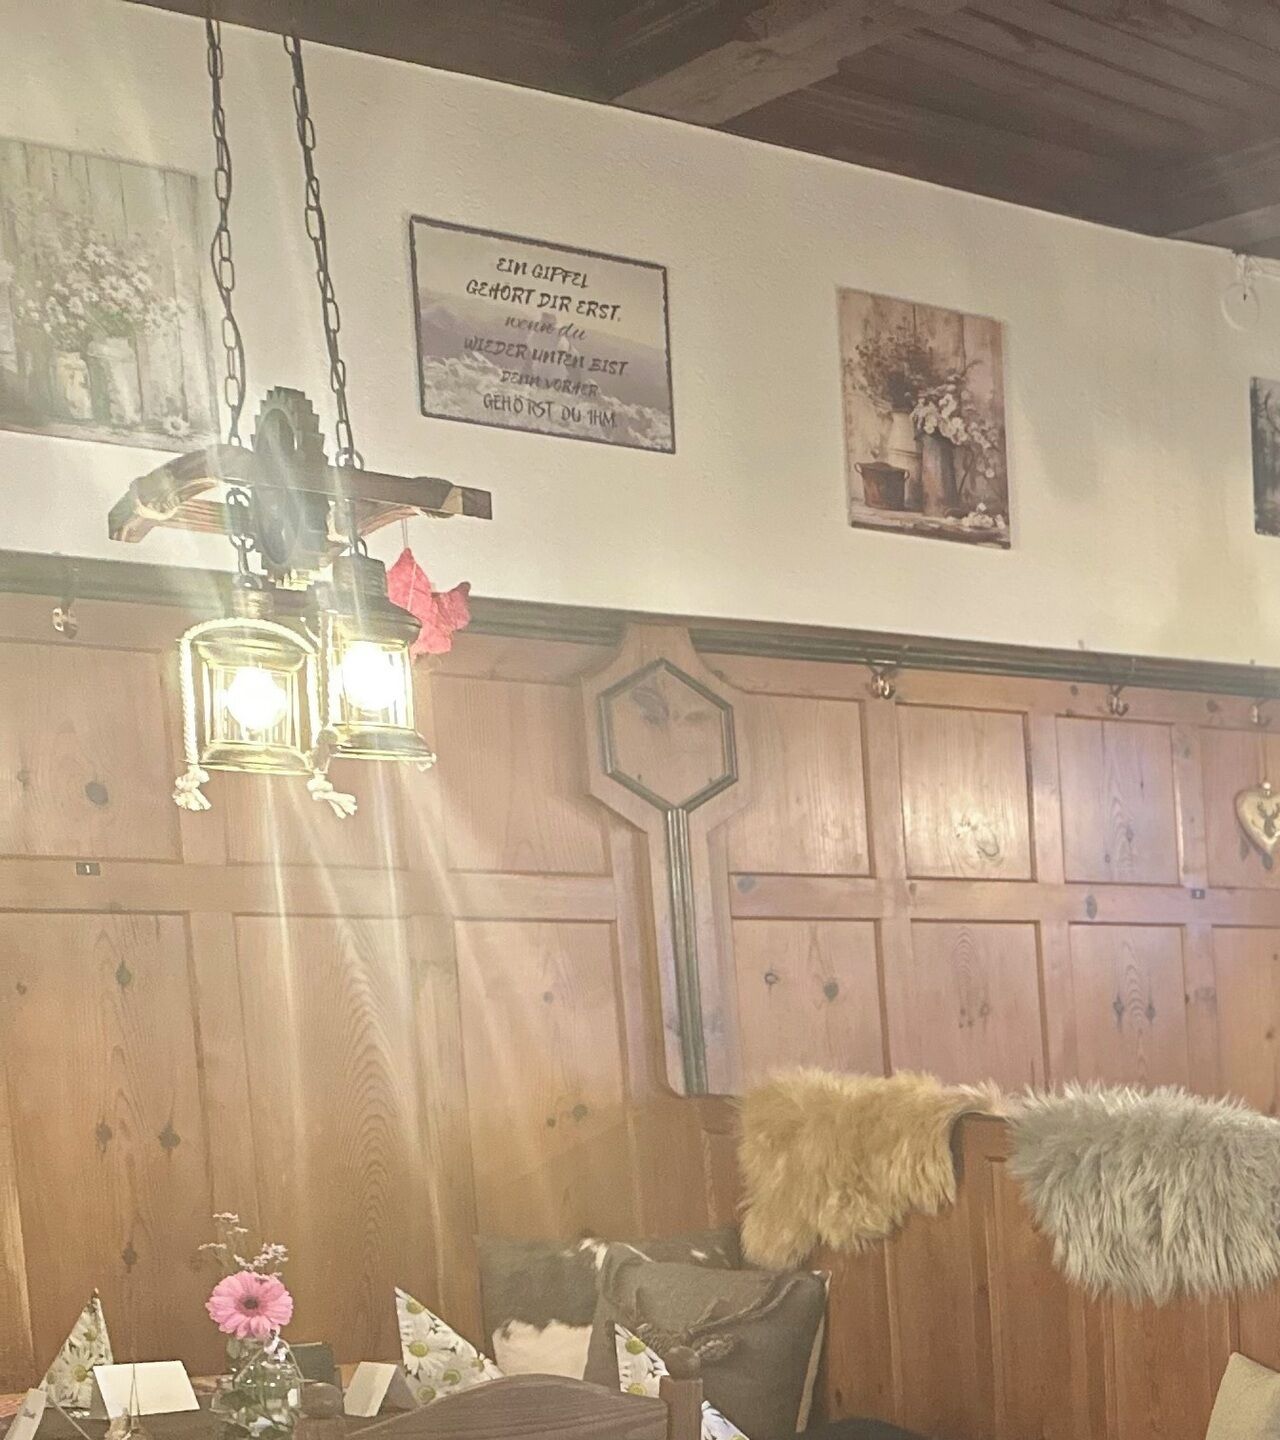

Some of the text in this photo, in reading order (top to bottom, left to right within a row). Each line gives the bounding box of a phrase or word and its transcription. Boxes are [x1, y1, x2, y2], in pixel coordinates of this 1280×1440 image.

[496, 257, 590, 289] EIN GIPFEL
[536, 292, 572, 313] DIR
[558, 322, 587, 341] du
[464, 336, 529, 360] WIEDER
[531, 348, 586, 369] UNTEN
[499, 370, 540, 388] DENN
[561, 405, 582, 423] DU
